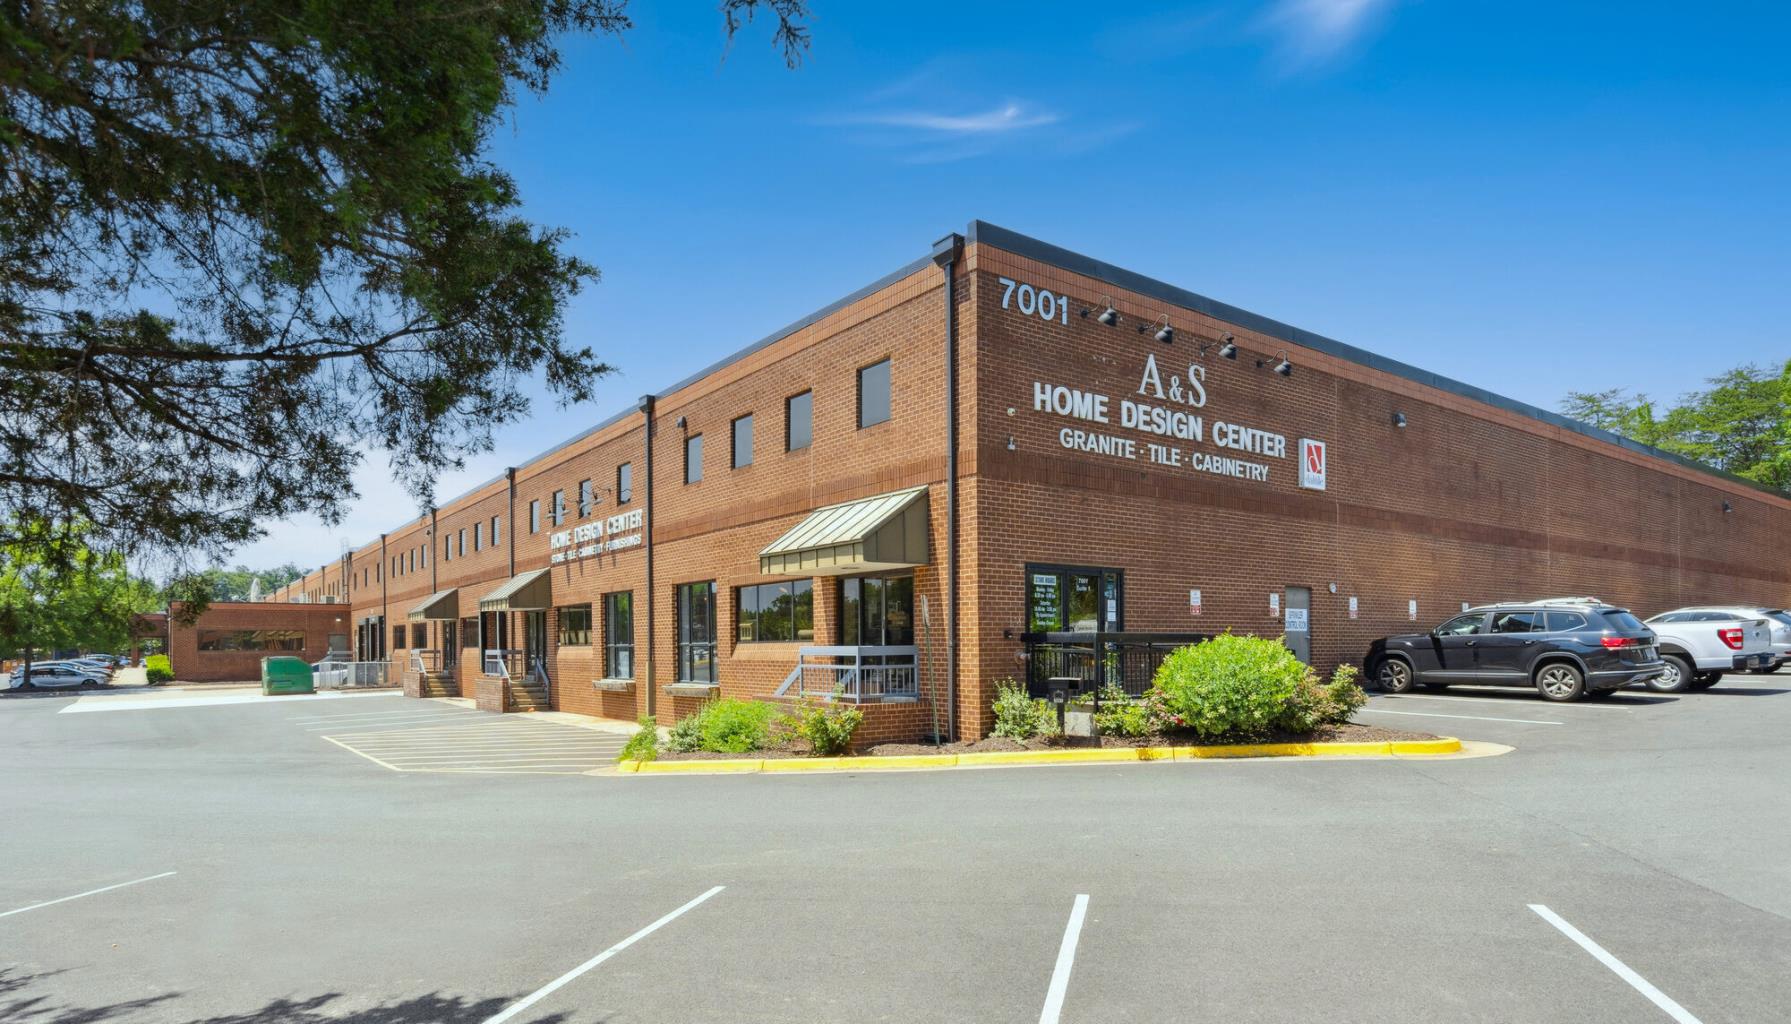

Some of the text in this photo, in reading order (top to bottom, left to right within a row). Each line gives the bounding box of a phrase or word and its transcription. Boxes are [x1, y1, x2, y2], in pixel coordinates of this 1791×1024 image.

[999, 277, 1068, 325] 7001
[1033, 381, 1286, 459] HOME DESIGN CENTER
[1059, 427, 1269, 482] GRANITE TILE CABINETRY
[550, 509, 642, 549] HOME DESIGN CENTER
